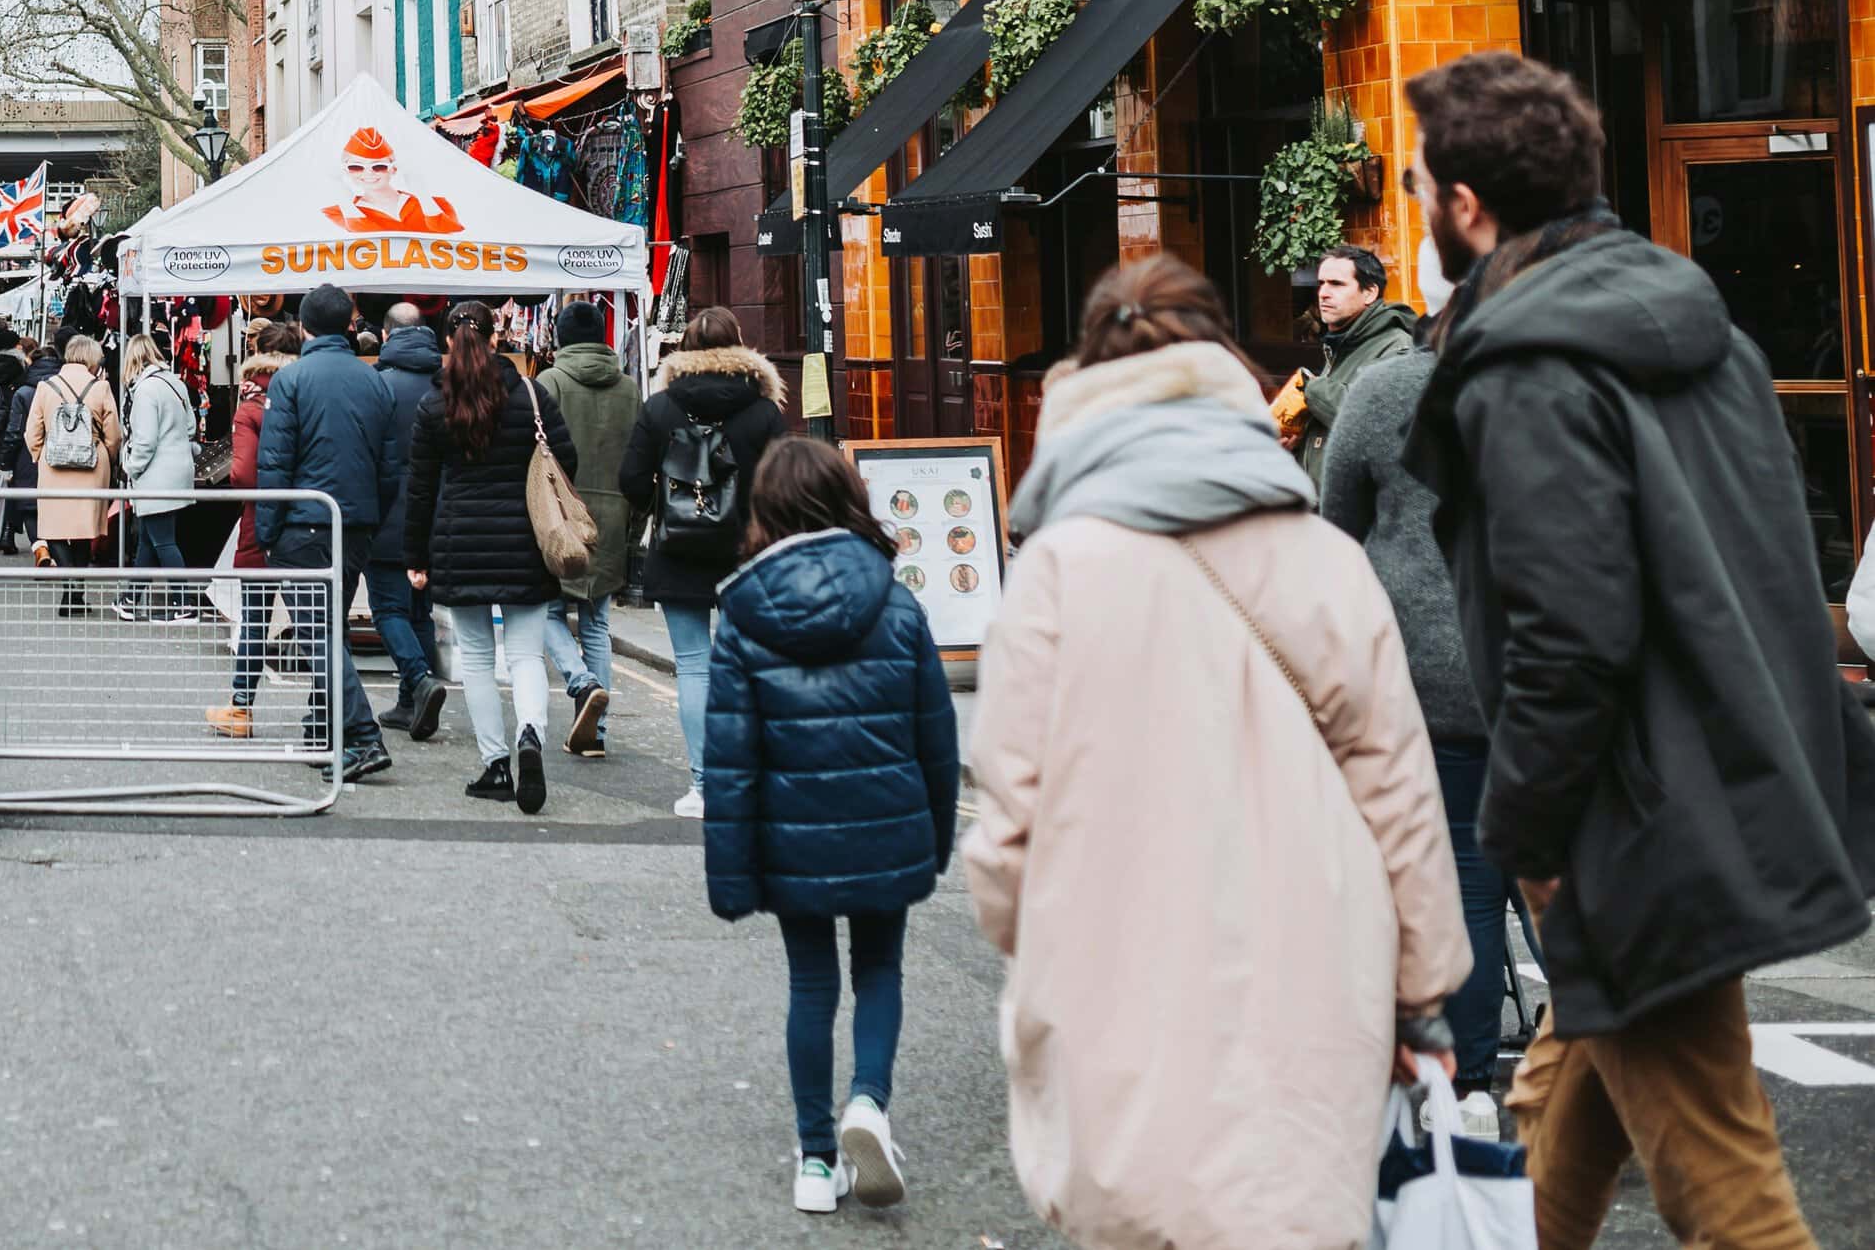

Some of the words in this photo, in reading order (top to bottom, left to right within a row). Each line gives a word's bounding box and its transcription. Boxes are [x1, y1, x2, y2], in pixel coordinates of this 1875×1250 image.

[973, 221, 993, 239] Sushi
[174, 251, 202, 262] 100%
[205, 251, 222, 261] UV
[260, 238, 529, 275] SUNGLASSES
[567, 250, 595, 260] 100%
[597, 249, 614, 259] UV
[169, 260, 226, 271] Protection
[563, 258, 619, 268] Protection
